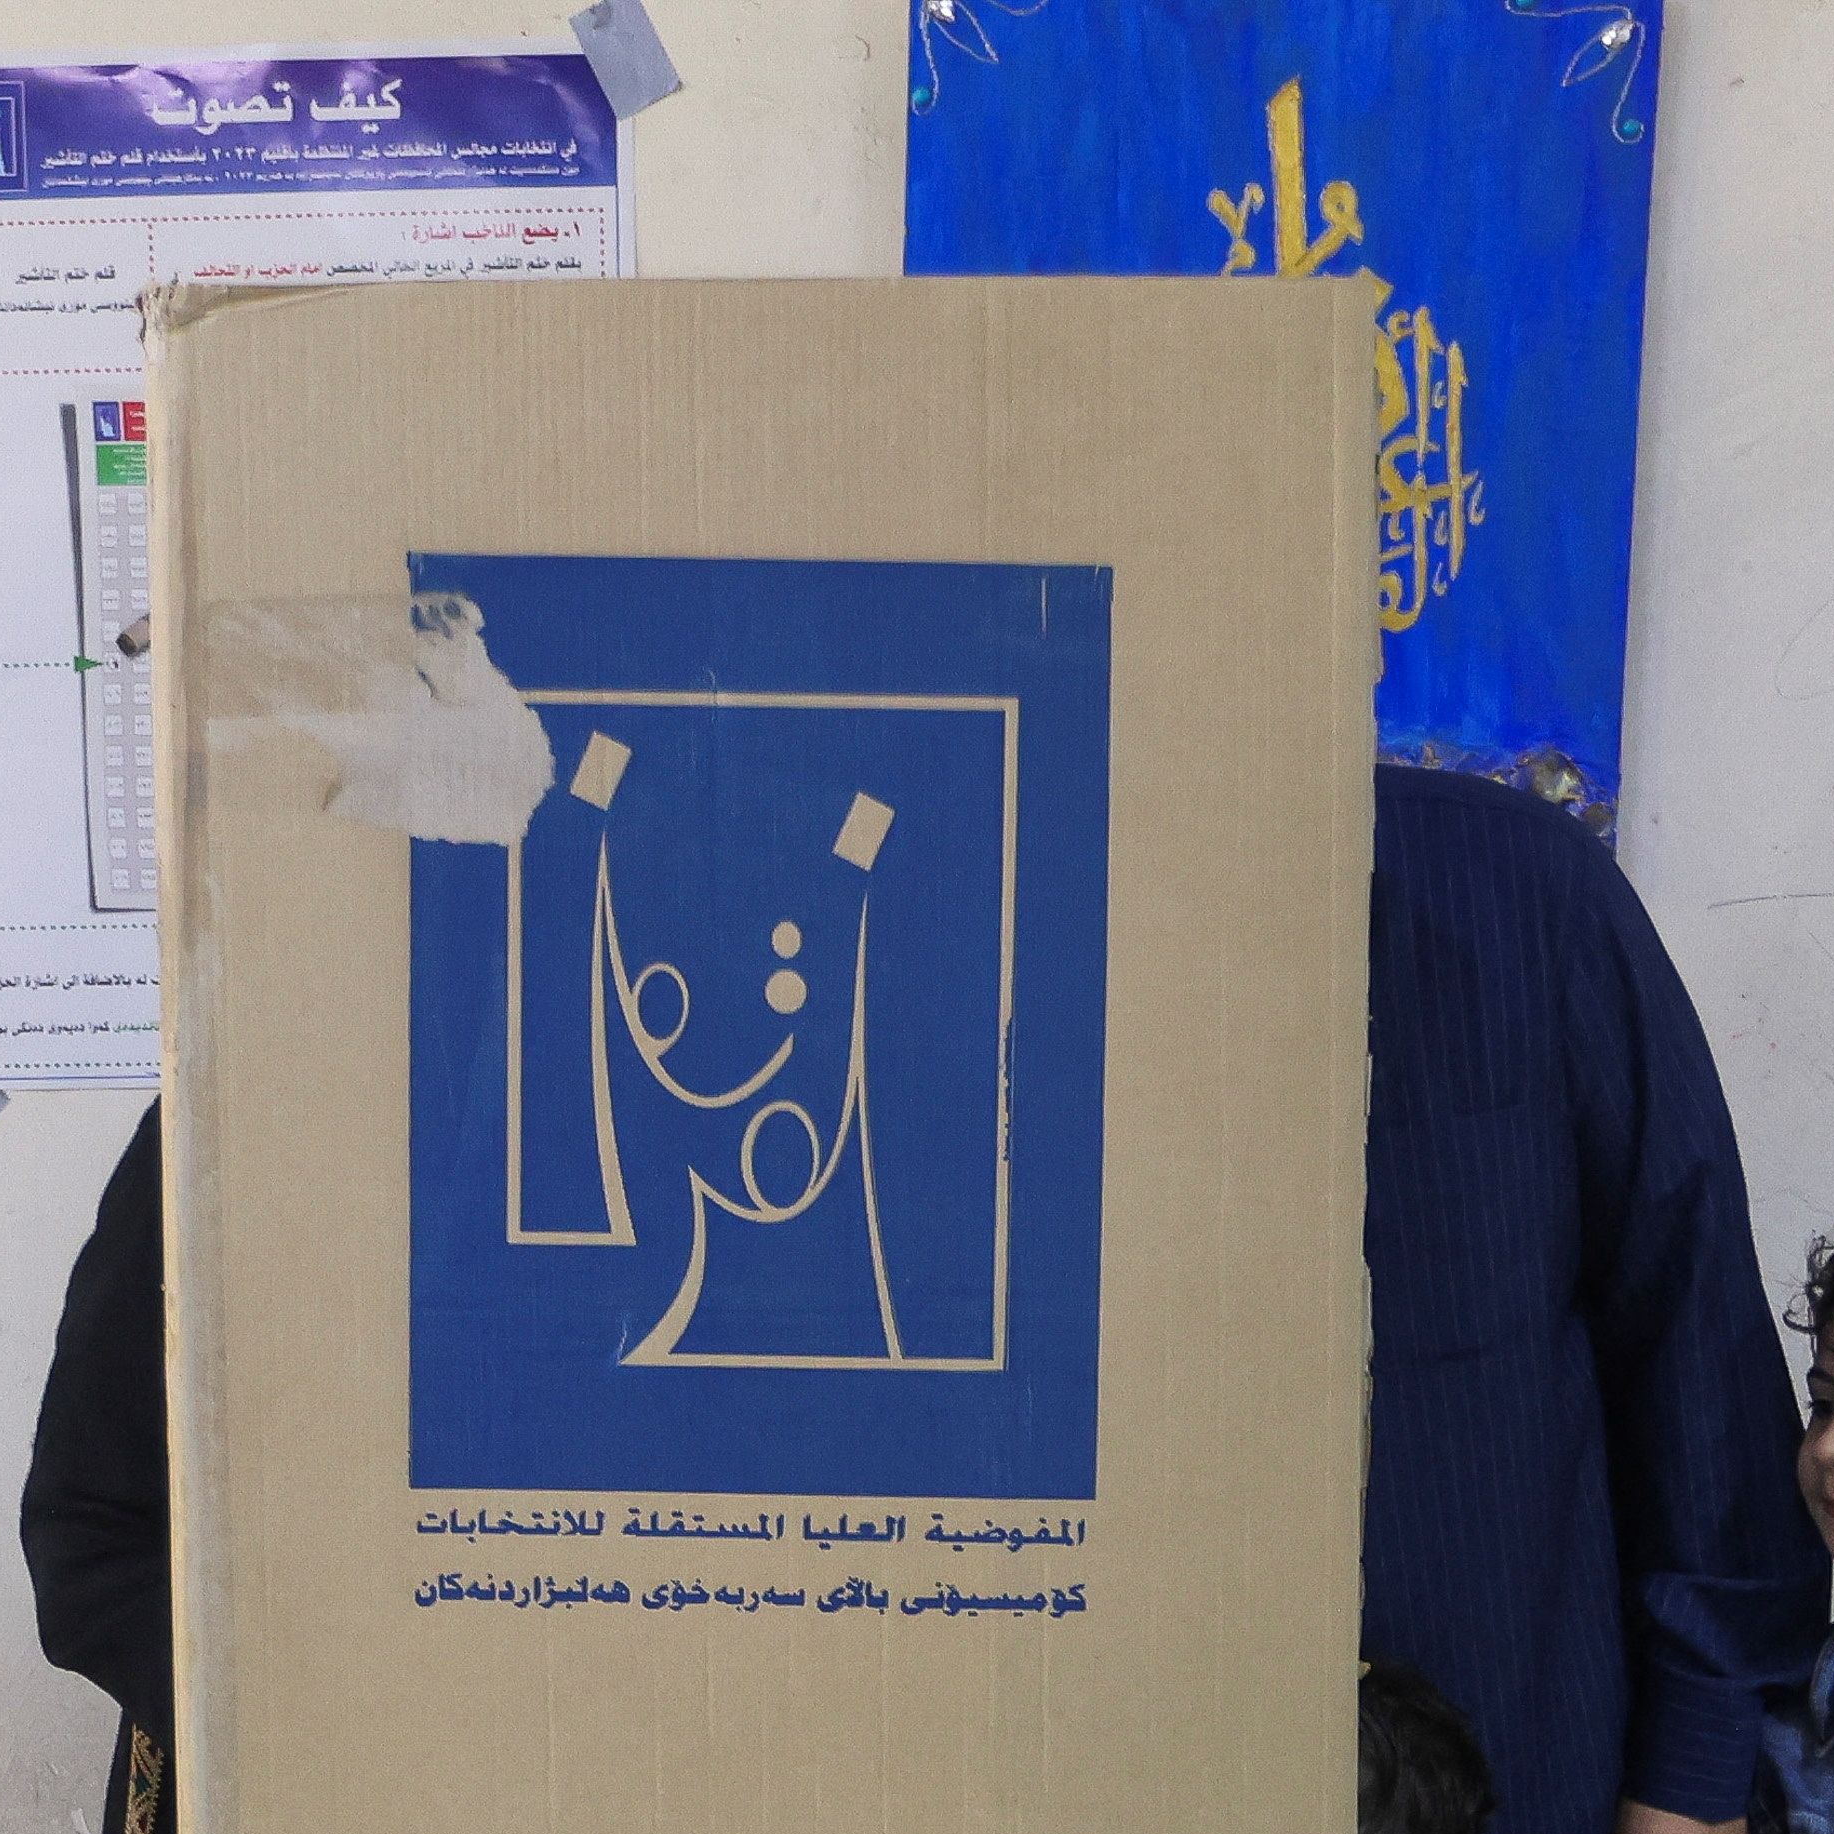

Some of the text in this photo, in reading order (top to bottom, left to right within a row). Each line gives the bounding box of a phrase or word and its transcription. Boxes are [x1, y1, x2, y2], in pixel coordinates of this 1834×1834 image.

[146, 77, 404, 135] كيف تصوت
[450, 142, 498, 161] مجالس
[559, 138, 578, 162] في
[461, 222, 517, 242] الناخب
[521, 226, 560, 245] يضع
[414, 1507, 1088, 1553] المفوضية العليا المستقلة للانتخابات
